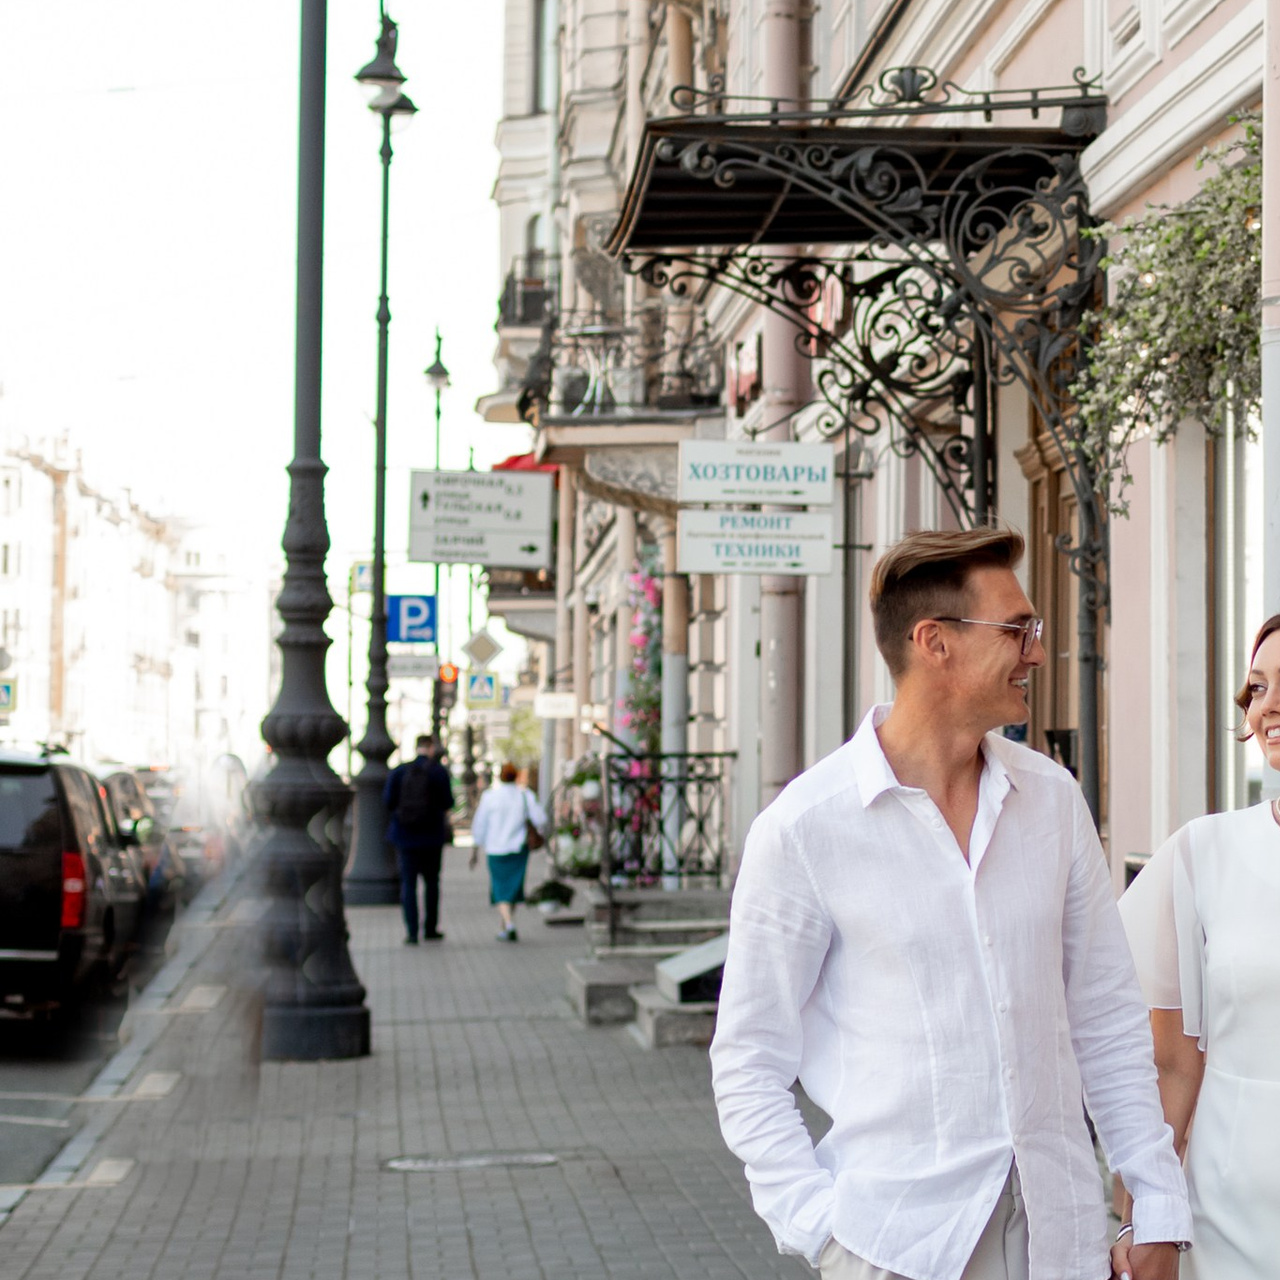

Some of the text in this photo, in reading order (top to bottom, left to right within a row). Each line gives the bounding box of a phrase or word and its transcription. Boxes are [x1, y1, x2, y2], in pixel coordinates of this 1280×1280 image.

[688, 462, 827, 483] ХОЗТОВАРЫ
[719, 515, 793, 530] РЕМОНТ
[713, 542, 801, 558] ТЕХНИКИ
